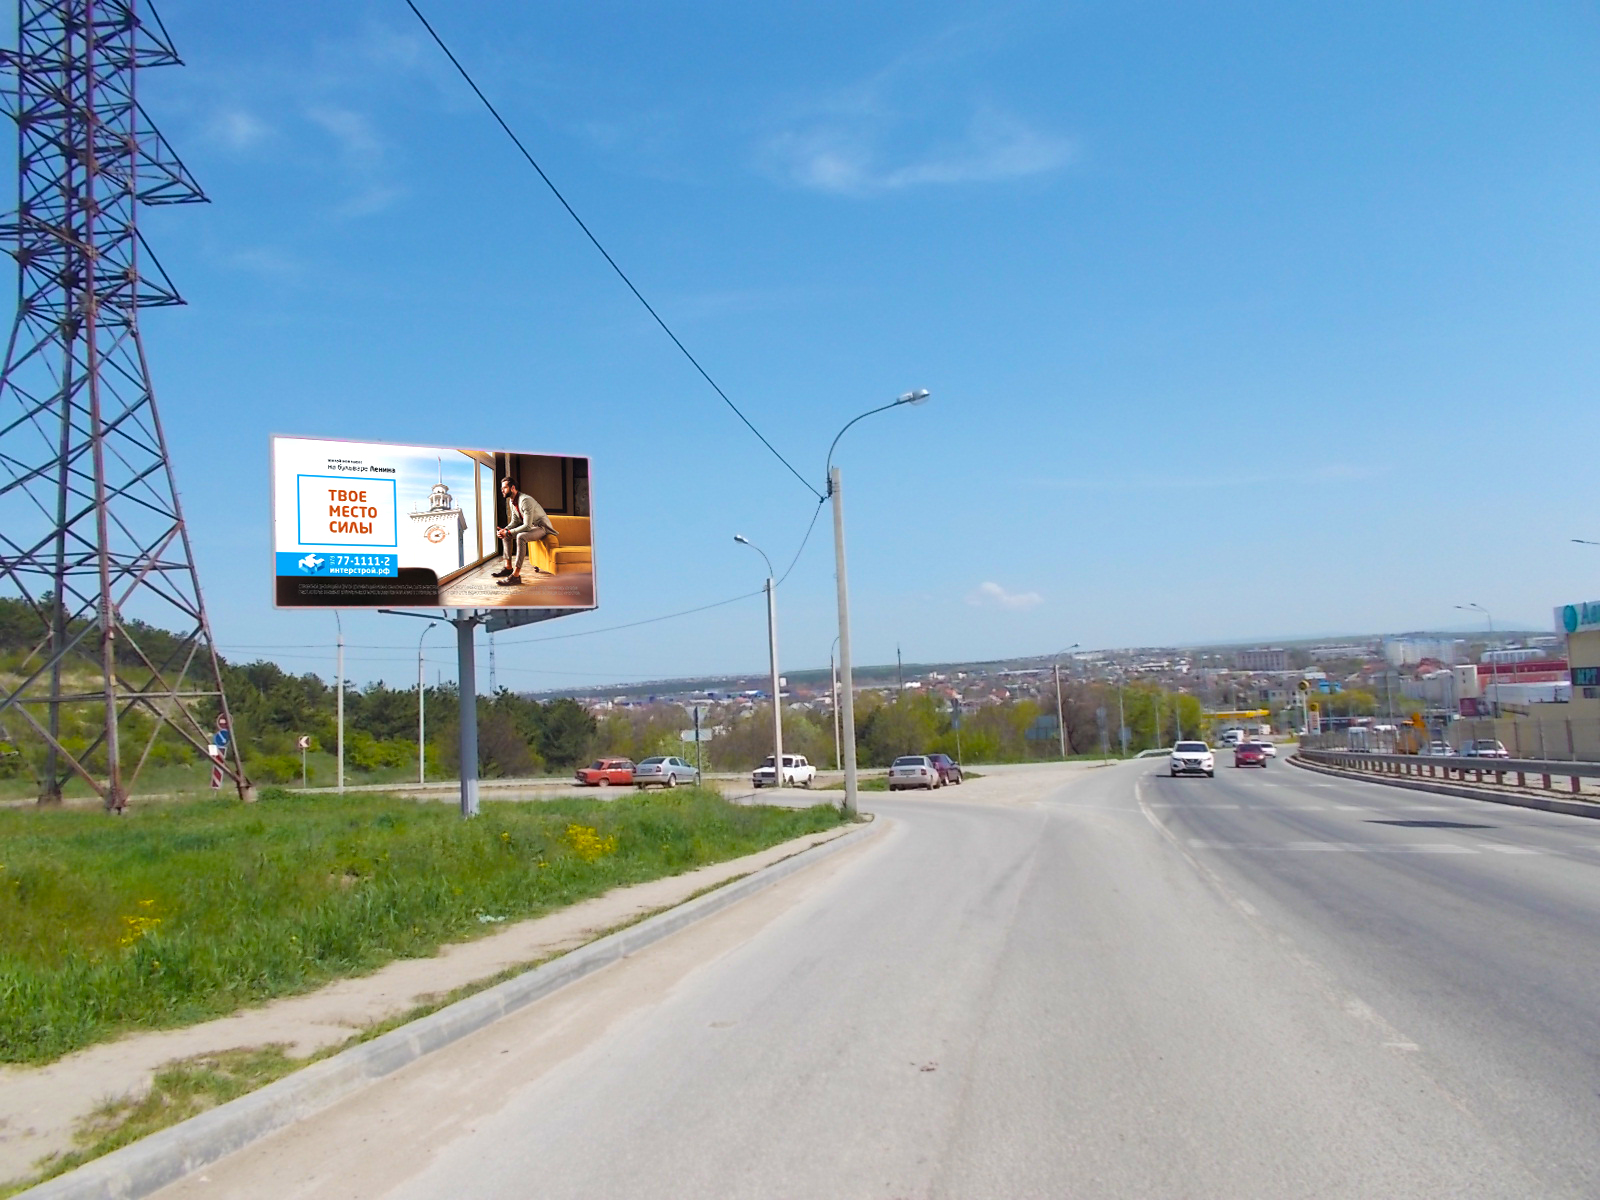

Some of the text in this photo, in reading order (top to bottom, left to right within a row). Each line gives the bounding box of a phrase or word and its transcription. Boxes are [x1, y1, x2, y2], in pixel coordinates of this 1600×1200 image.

[370, 465, 396, 474] Ленина
[328, 489, 367, 502] ТВОЕ
[329, 505, 377, 518] МЕСТО
[329, 521, 372, 534] СИЛЫ
[337, 556, 390, 566] 77-1111-2
[329, 567, 390, 575] интерстрой.рф
